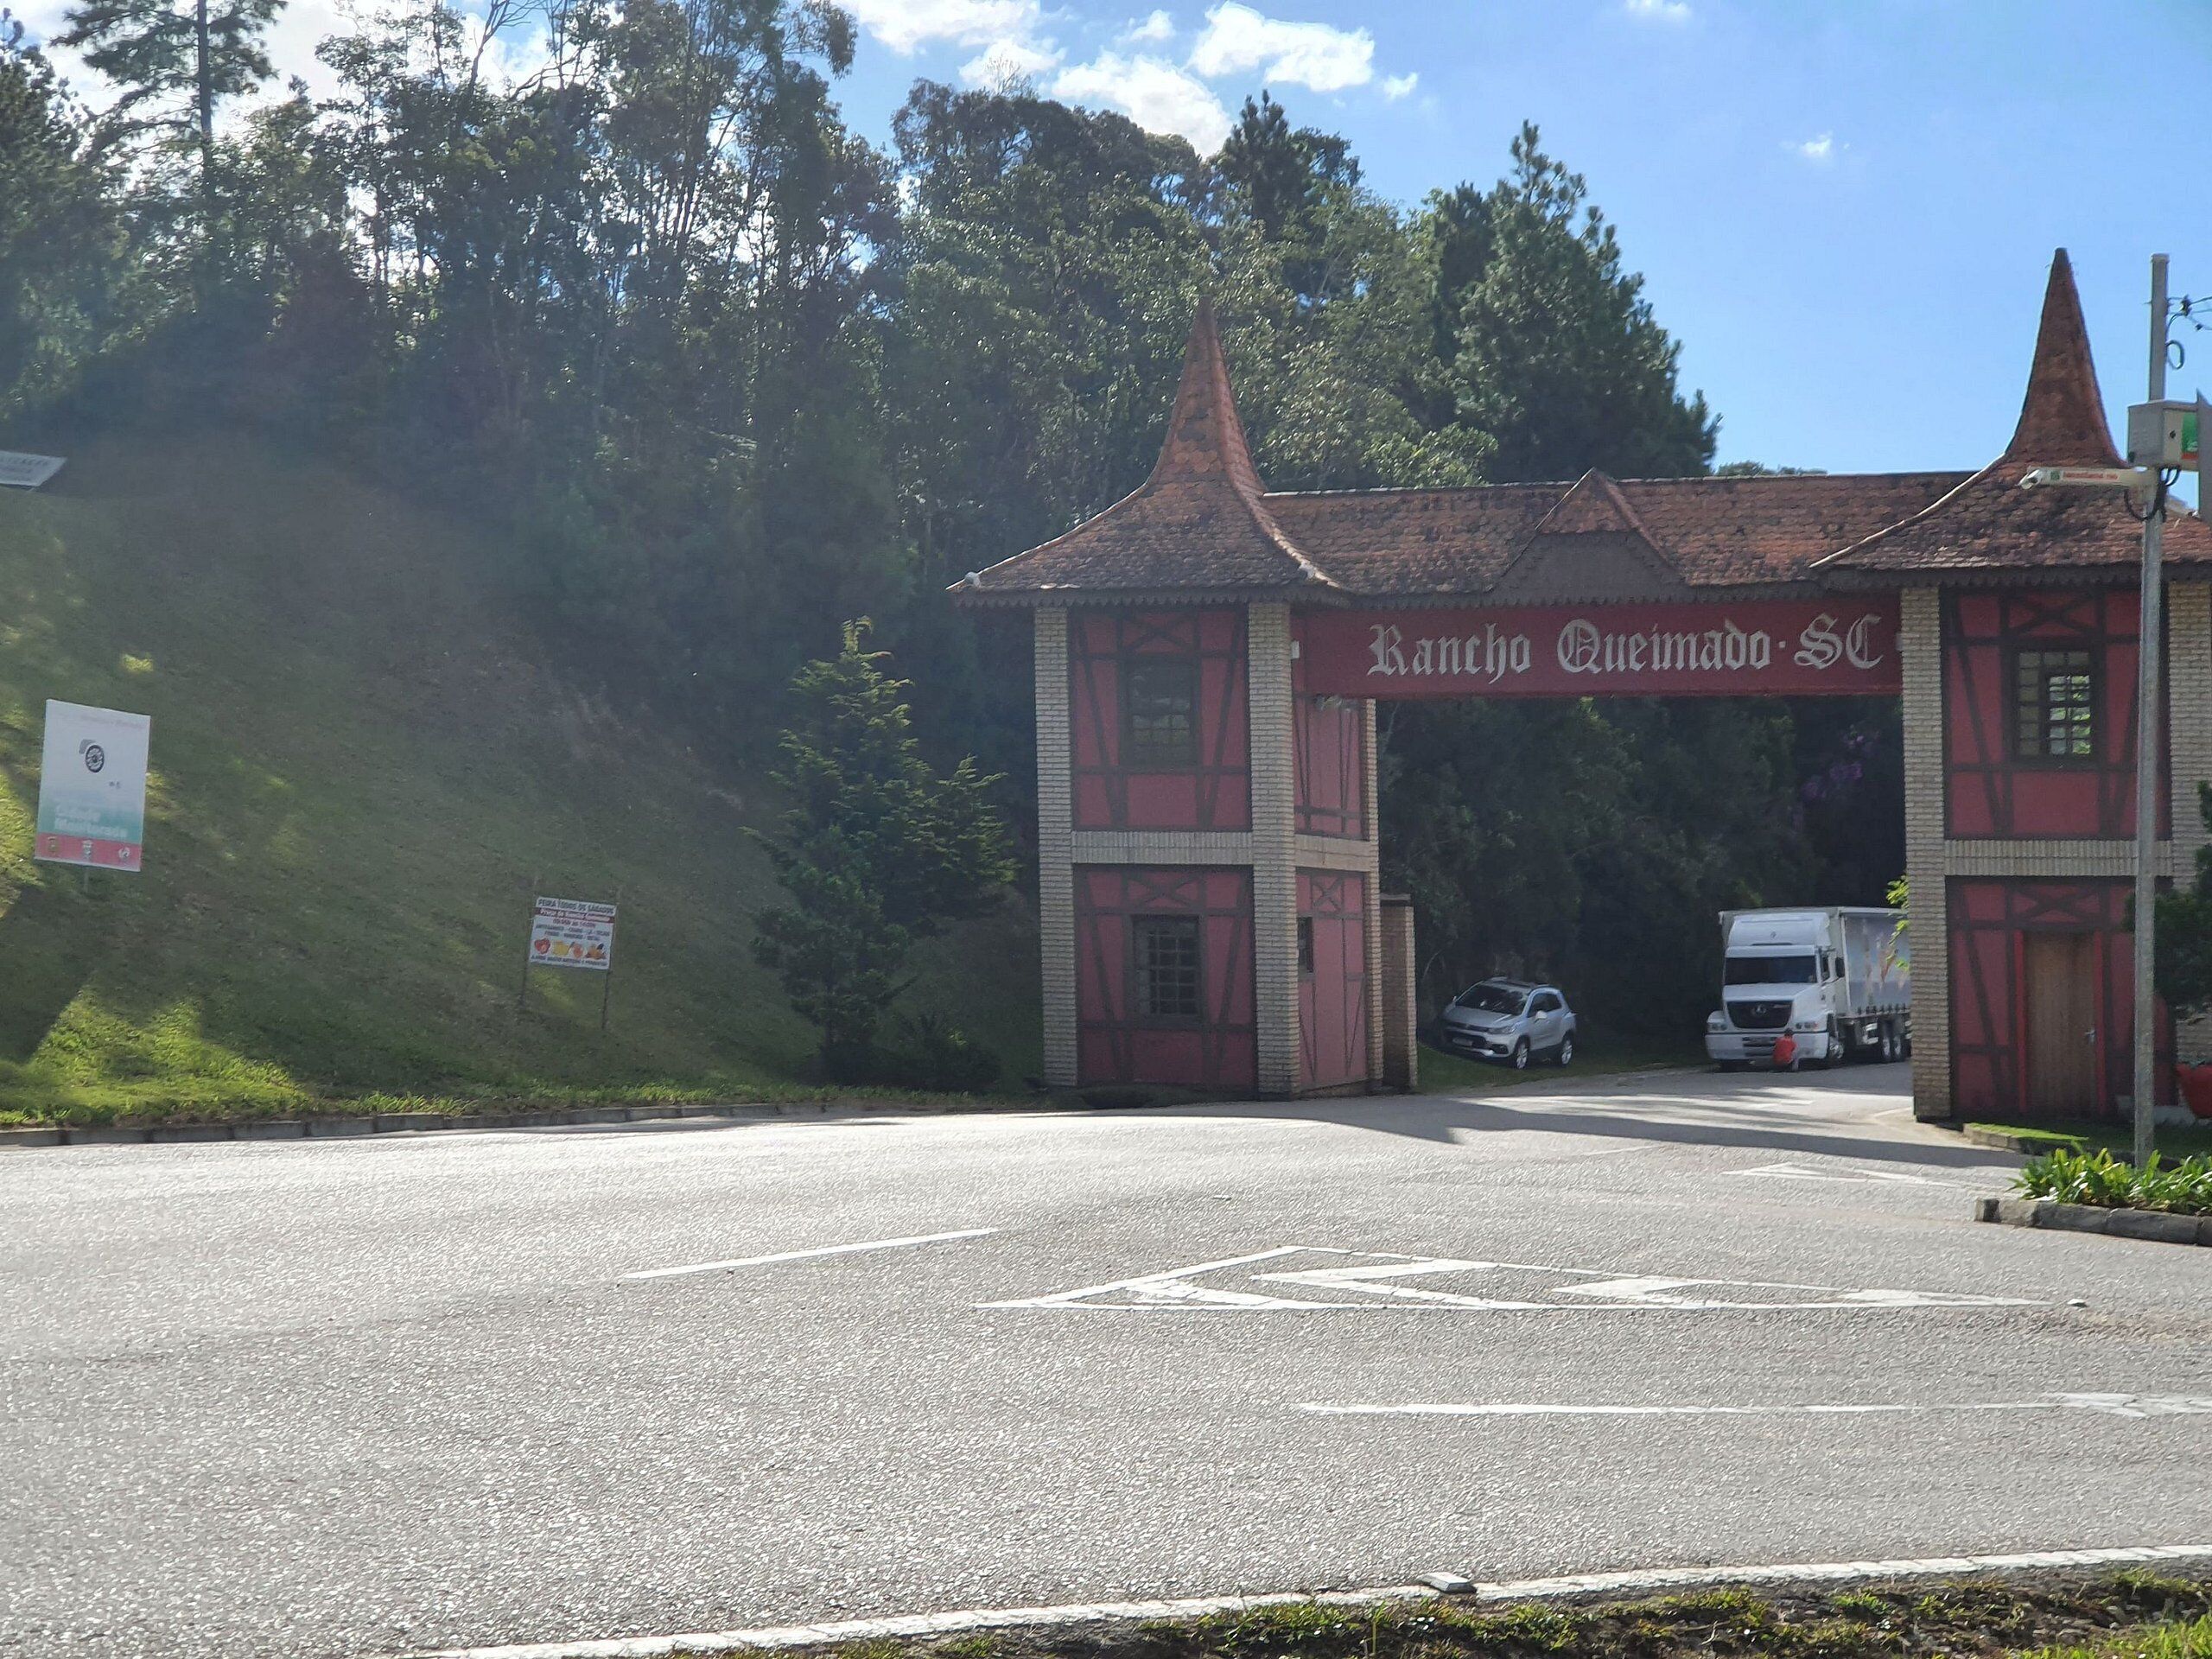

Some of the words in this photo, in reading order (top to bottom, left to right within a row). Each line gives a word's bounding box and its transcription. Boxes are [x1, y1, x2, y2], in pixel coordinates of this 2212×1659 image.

[1367, 622, 1531, 684] Rancho
[1556, 618, 1770, 675] Queimado
[1794, 613, 1883, 669] SC
